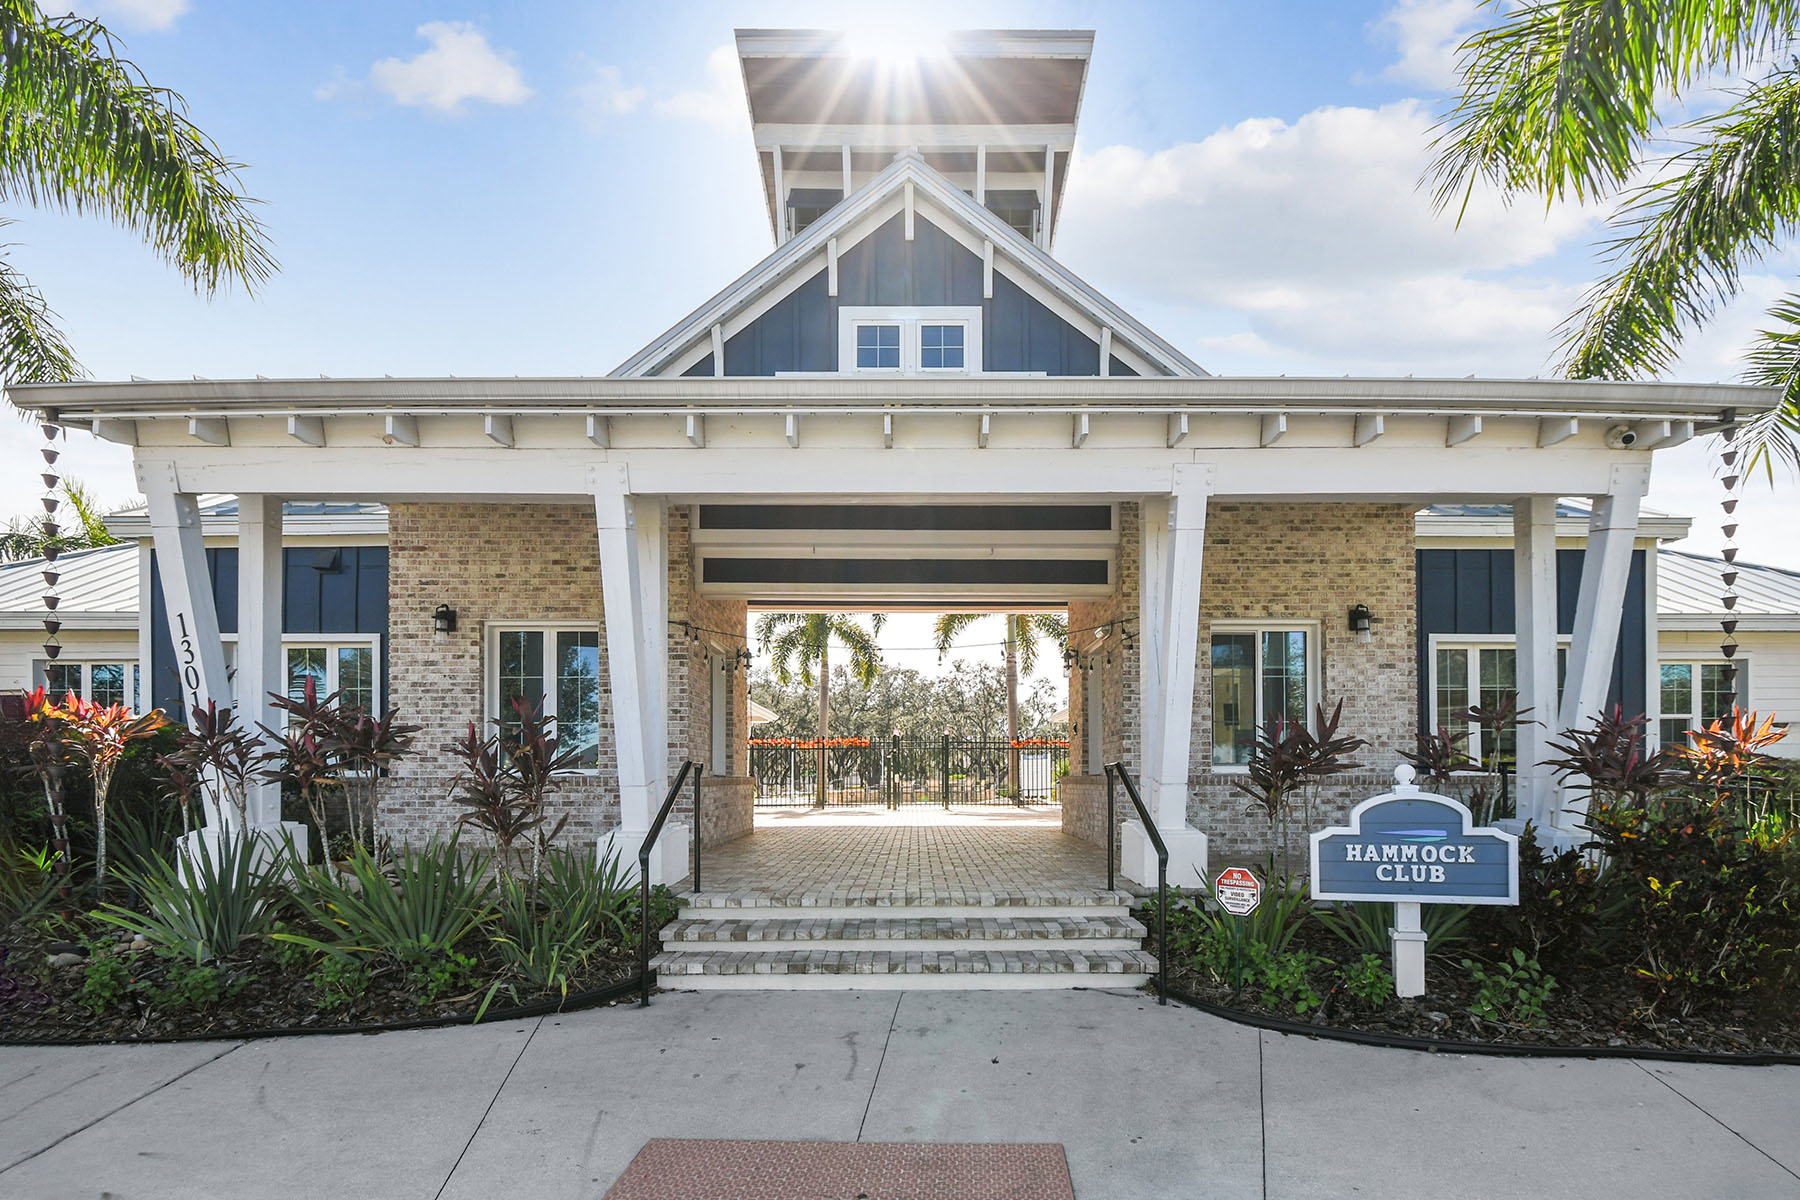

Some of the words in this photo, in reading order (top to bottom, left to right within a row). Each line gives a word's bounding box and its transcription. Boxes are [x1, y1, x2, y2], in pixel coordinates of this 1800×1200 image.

[176, 612, 200, 707] 1301
[1345, 844, 1476, 864] HAMMOCK
[1376, 864, 1446, 882] CLUB
